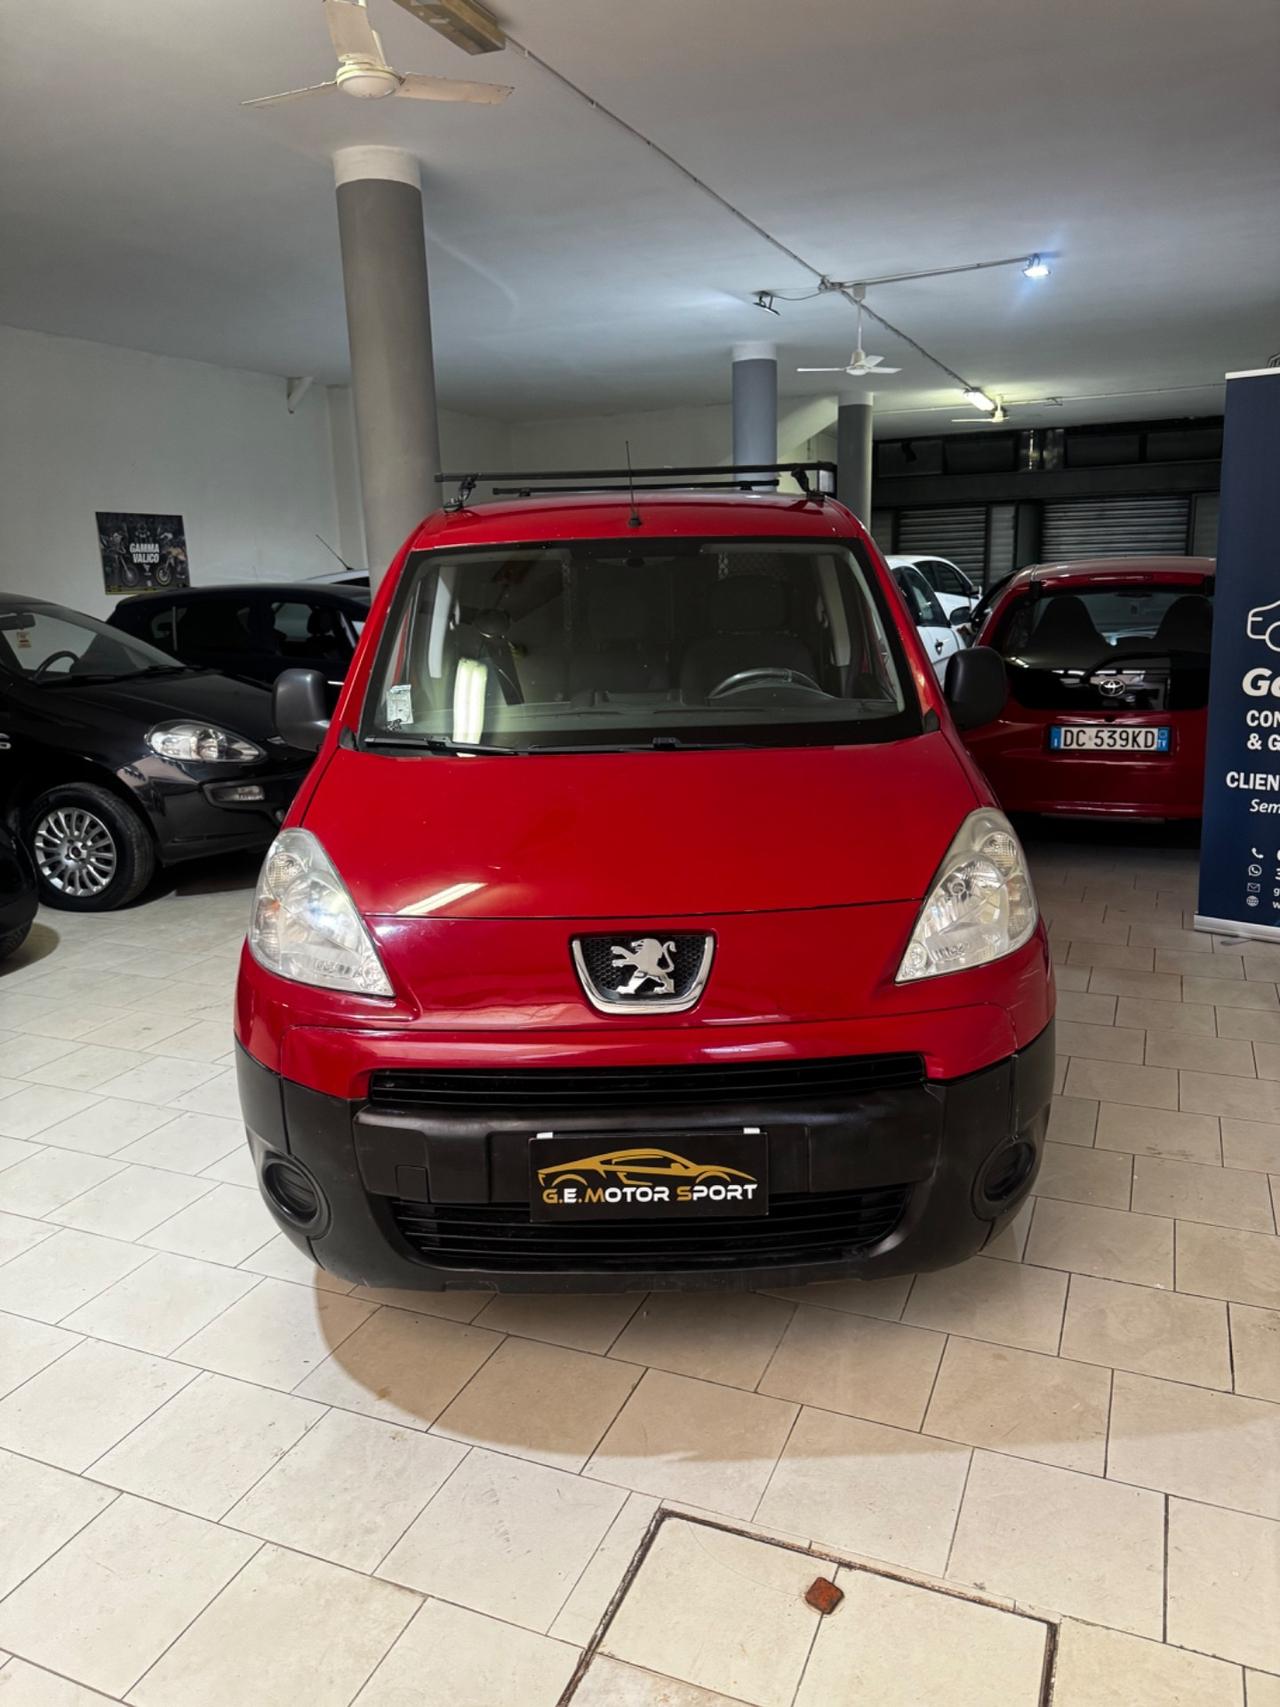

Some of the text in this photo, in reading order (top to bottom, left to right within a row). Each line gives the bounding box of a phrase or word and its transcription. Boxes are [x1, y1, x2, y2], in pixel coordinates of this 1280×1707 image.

[129, 543, 160, 553] GAMMA
[132, 553, 160, 564] VALICO
[1246, 733, 1262, 750] &
[1226, 771, 1280, 791] CLIEN
[676, 1183, 758, 1201] SPORT
